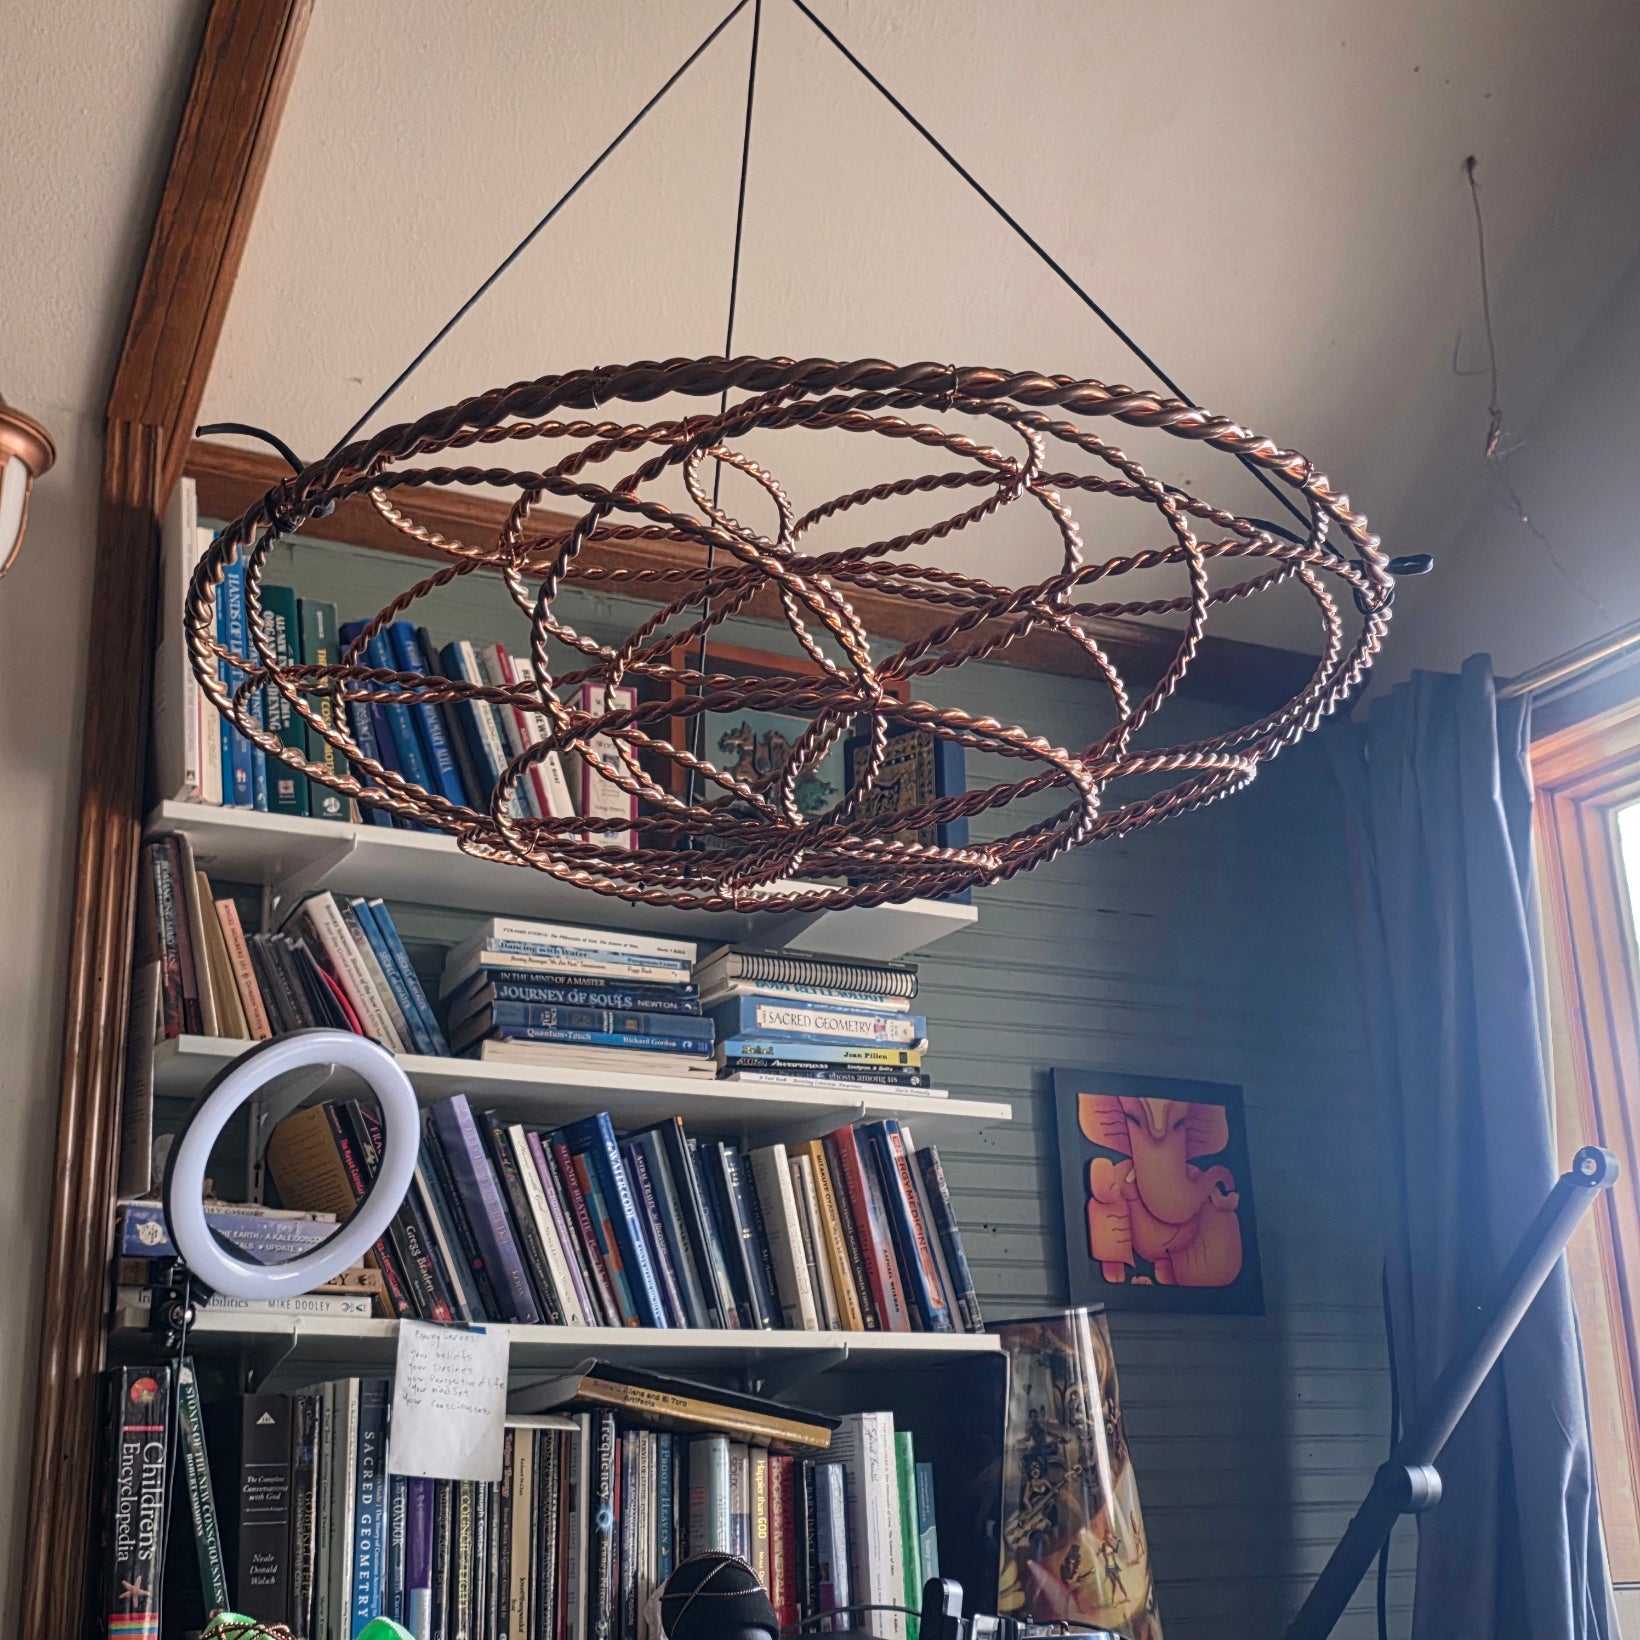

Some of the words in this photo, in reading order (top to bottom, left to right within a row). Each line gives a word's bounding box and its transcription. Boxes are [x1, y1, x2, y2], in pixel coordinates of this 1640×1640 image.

[227, 573, 240, 619] HANDS
[230, 621, 241, 637] OF
[500, 942, 536, 953] Dancing
[539, 945, 561, 955] with
[561, 946, 588, 958] Water
[500, 972, 510, 980] IN
[512, 973, 527, 981] THE
[530, 974, 551, 983] MIND
[555, 976, 565, 984] OF
[566, 977, 574, 985] A
[574, 977, 605, 986] MASTER
[500, 985, 564, 1001] JOURNEY
[567, 988, 586, 1003] OF
[589, 992, 633, 1008] SOULS
[637, 1000, 678, 1010] NEWTON
[769, 1011, 812, 1028] SACRED
[815, 1016, 872, 1036] GEOMETRY
[527, 1028, 592, 1041] Quantum-Touch
[623, 1036, 650, 1045] Richard
[651, 1038, 677, 1047] Gordon
[771, 1060, 828, 1070] Awareness
[843, 1051, 862, 1059] Joan
[864, 1052, 888, 1060] Pillen
[829, 1073, 855, 1083] ghosts
[856, 1075, 886, 1085] among
[557, 1144, 579, 1187] MELODY
[571, 1188, 594, 1232] BEATTIE
[606, 1149, 628, 1188] WATER
[618, 1189, 636, 1220] CODE
[814, 1153, 830, 1191] MITAKUYE
[823, 1193, 837, 1222] OYASIN
[888, 1134, 913, 1193] ENERGY
[904, 1193, 931, 1255] MEDICINE
[234, 1230, 259, 1238] EARTH
[266, 1244, 295, 1252] UPDATE
[402, 1224, 423, 1256] Gregg
[415, 1256, 436, 1293] Braden
[882, 1248, 894, 1278] RAPHAEL
[268, 1300, 290, 1309] MIKE
[295, 1300, 331, 1311] DOOLEY
[185, 1386, 201, 1432] STONES
[646, 1392, 660, 1401] and
[671, 1397, 688, 1407] Toro
[192, 1432, 203, 1447] OF
[185, 1453, 197, 1489] ROBERT
[194, 1451, 206, 1474] THE
[361, 1431, 373, 1504] SACRED
[728, 1456, 738, 1488] SIOUX
[197, 1476, 210, 1502] NEW
[258, 1476, 285, 1484] Complete
[755, 1460, 765, 1495] Happier
[772, 1461, 782, 1513] ROCKS
[116, 1442, 140, 1562] Encyclopedia
[139, 1442, 164, 1560] Children's
[249, 1493, 265, 1501] with
[757, 1496, 765, 1515] than
[190, 1491, 204, 1536] SIMMONS
[391, 1497, 403, 1546] CONDOR
[774, 1516, 782, 1527] &
[373, 1521, 381, 1538] Story
[757, 1517, 766, 1539] GOD
[201, 1504, 225, 1603] CONSCIOUSNESS
[253, 1554, 275, 1563] Neale
[357, 1514, 370, 1618] GEOMETRY
[598, 1540, 608, 1573] Penney
[250, 1564, 278, 1574] Donald
[251, 1575, 276, 1585] Walsch
[774, 1530, 784, 1606] MINERALS
[370, 1576, 379, 1608] According
